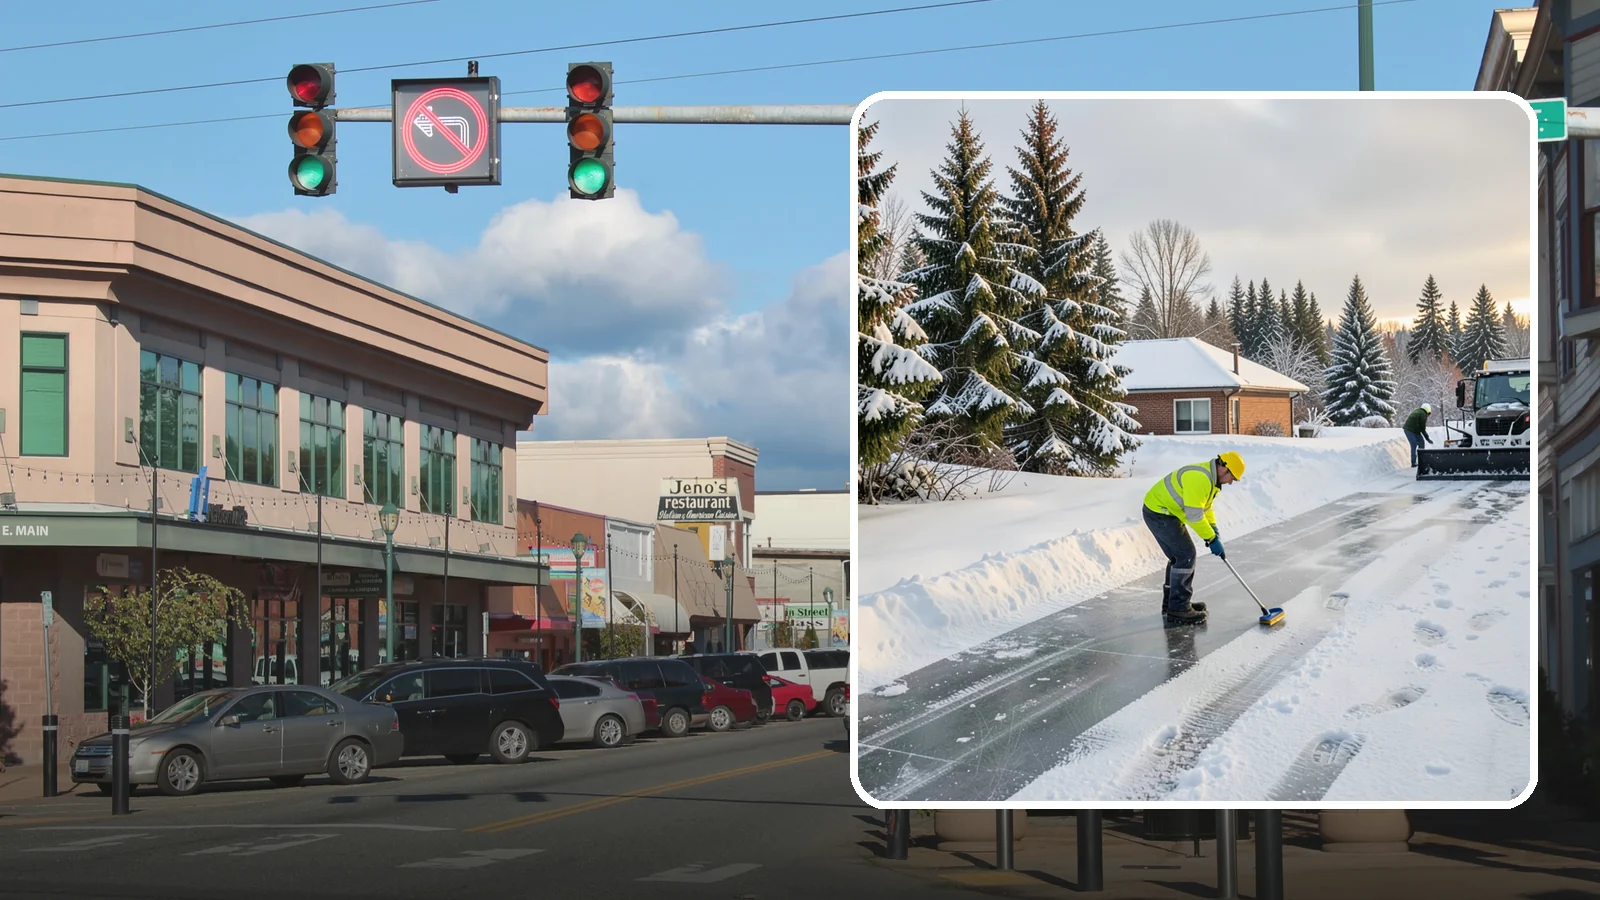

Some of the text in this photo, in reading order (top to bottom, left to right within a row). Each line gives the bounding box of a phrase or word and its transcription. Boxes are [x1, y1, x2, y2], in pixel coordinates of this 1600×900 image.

[669, 480, 728, 494] Jeno's
[665, 496, 731, 509] restaurant
[658, 509, 681, 519] Italian
[685, 509, 715, 519] American
[715, 509, 737, 519] Cuisine
[2, 525, 49, 536] E. MAIN
[797, 607, 828, 617] Street
